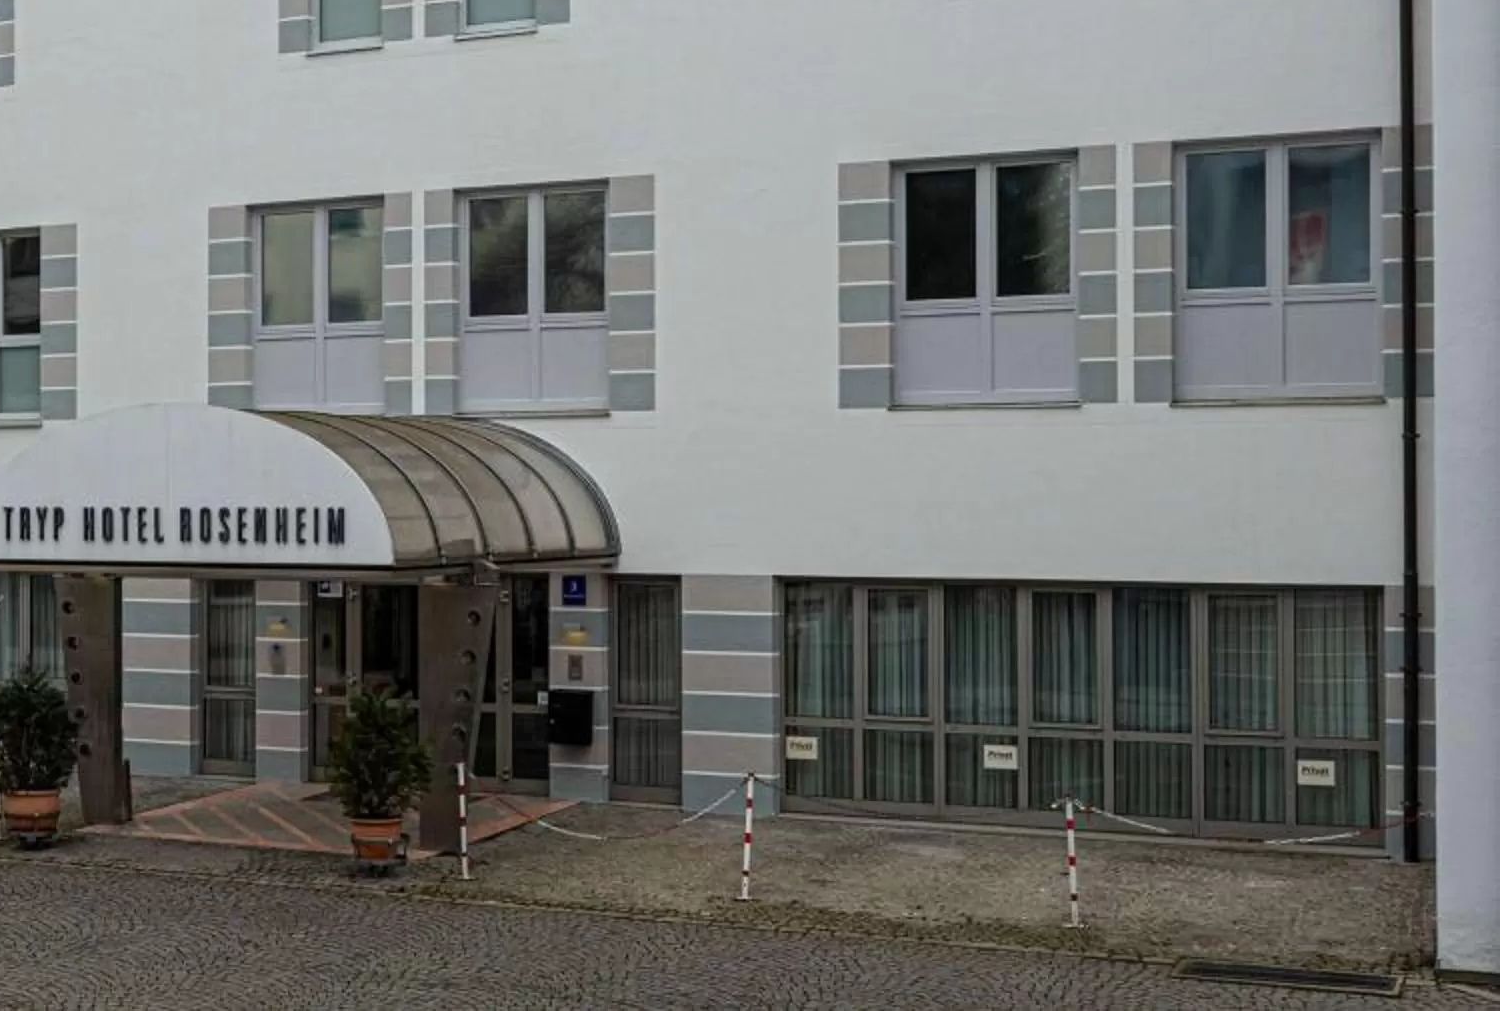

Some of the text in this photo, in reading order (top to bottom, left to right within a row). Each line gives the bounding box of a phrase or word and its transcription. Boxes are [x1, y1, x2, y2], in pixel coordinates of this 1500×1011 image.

[3, 507, 345, 545] TRYP HOTEL ROSENHEIM
